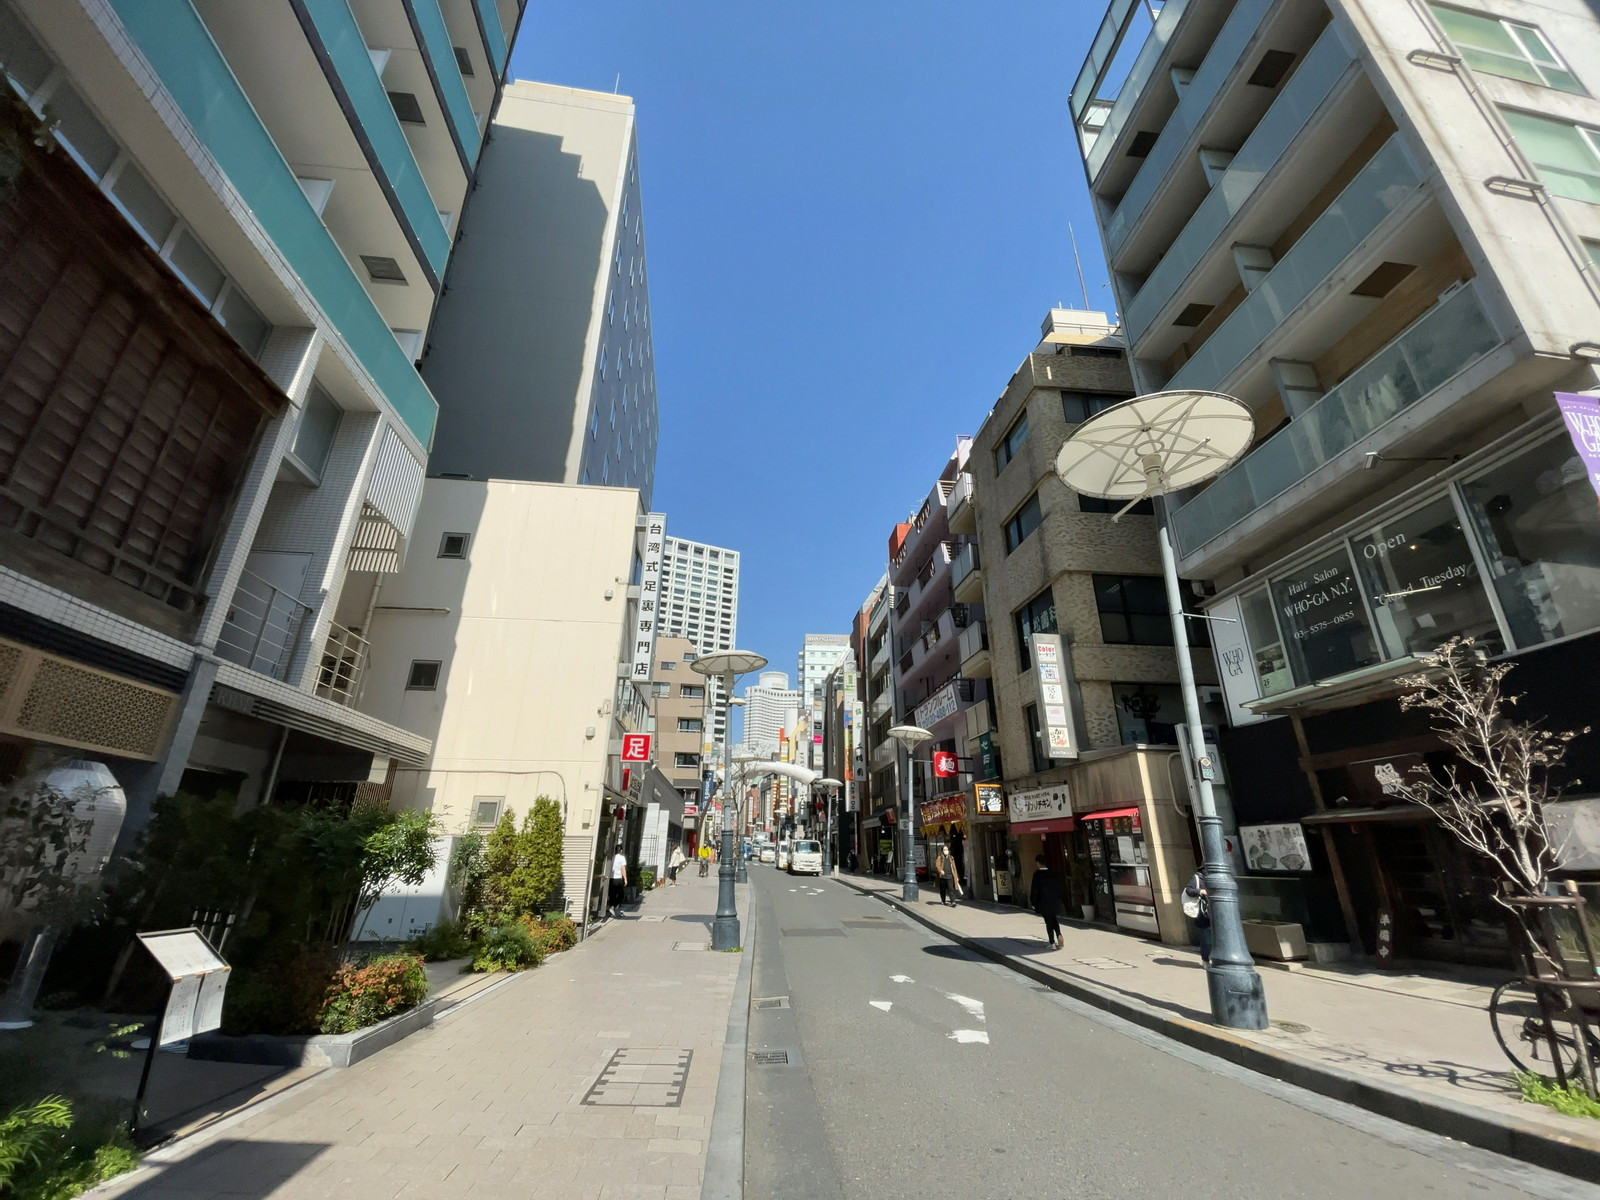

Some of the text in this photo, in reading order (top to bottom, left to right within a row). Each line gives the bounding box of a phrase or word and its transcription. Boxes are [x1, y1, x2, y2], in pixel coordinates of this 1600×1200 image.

[1363, 533, 1407, 559] Open
[1287, 567, 1338, 596] Hair Salon
[1419, 563, 1467, 588] Tuesday
[633, 522, 662, 676] 台湾式足裏専門店
[1283, 579, 1353, 618] WHO-GA N.Y.
[1293, 610, 1356, 640] 03-5575-0855
[1221, 647, 1244, 667] WHO
[1227, 660, 1244, 677] GA
[626, 737, 646, 759] 足
[937, 755, 957, 774] 麺
[1378, 913, 1391, 959] 準備中
